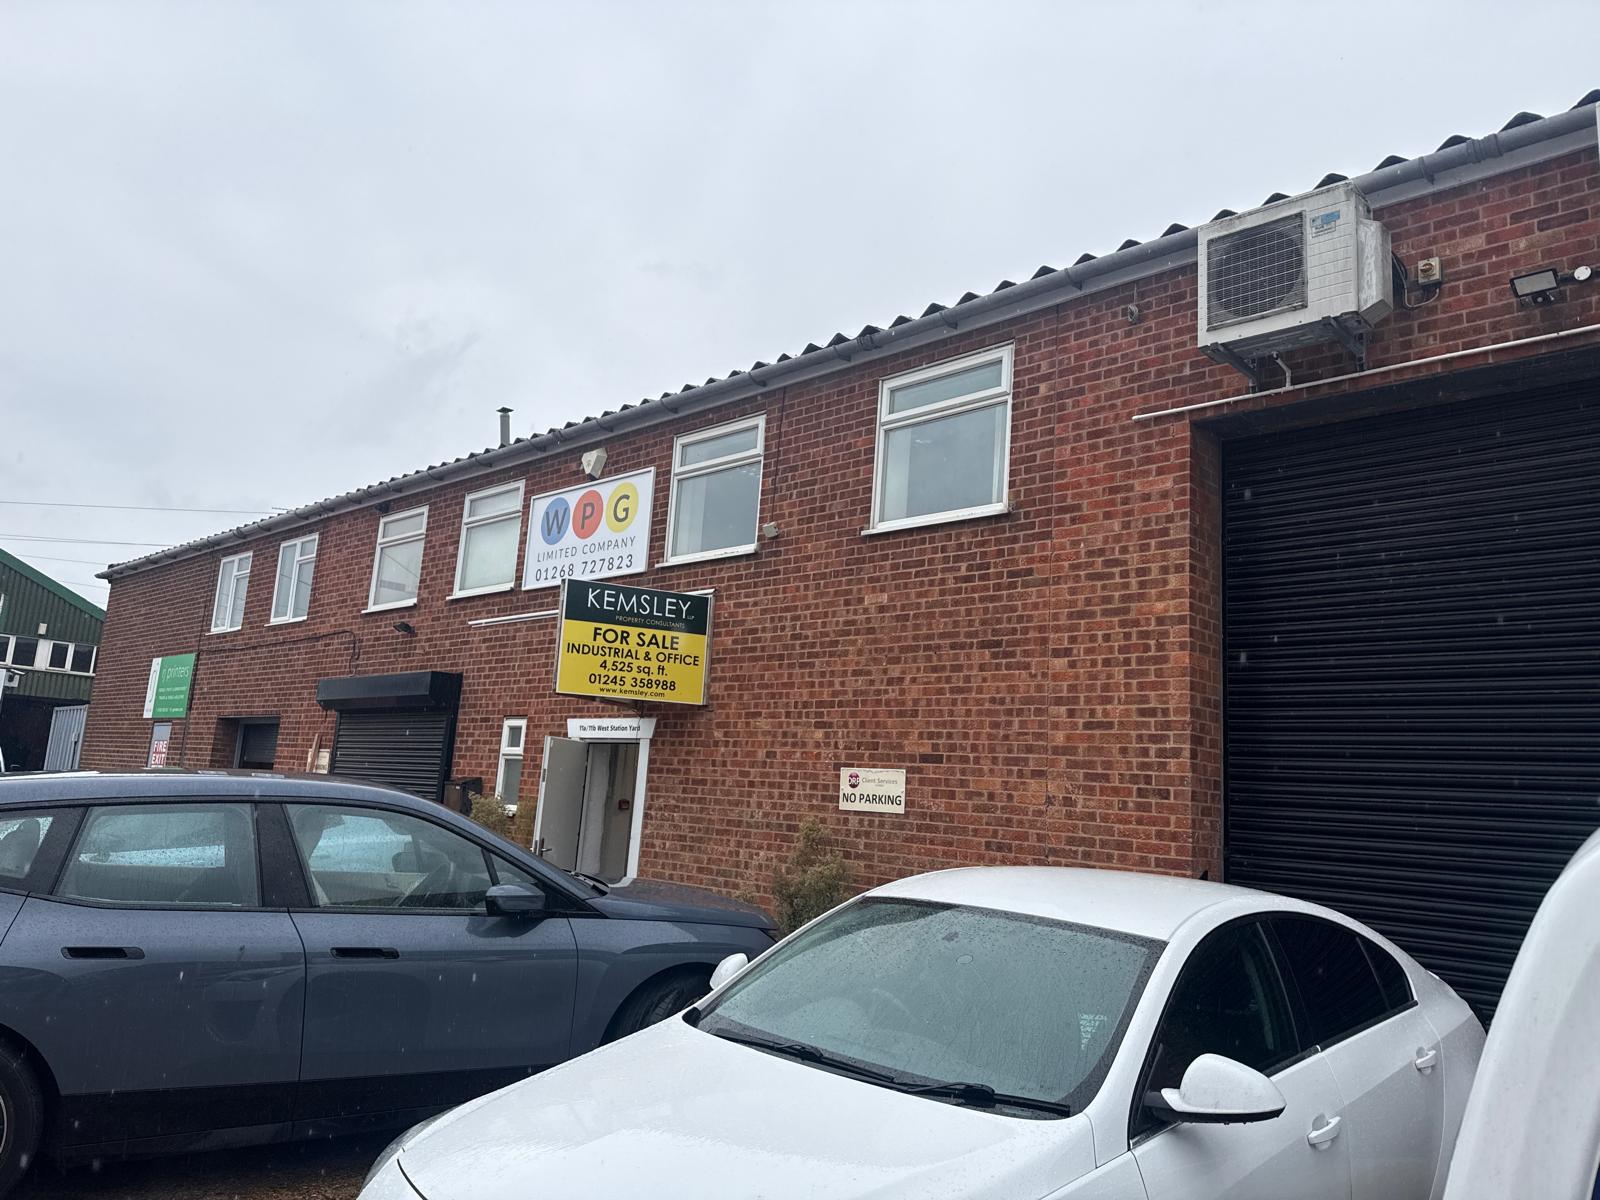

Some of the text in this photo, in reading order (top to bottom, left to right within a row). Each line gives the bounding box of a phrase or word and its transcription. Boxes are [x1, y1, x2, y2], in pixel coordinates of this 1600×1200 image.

[537, 536, 636, 563] LIMITED COMPANY
[535, 554, 633, 582] 01268 727823
[587, 588, 691, 619] KEMSLEY
[615, 615, 686, 629] PROPERTY CONSULTANTS
[593, 627, 680, 650] FOR SALE
[566, 642, 699, 666] INDUSTRIAL & OFFICE
[599, 660, 668, 677] 4,525 sq. ft.
[588, 673, 676, 691] 01245 358988
[599, 686, 665, 698] www.kemsley.com
[153, 740, 168, 752] FIRE
[151, 753, 166, 765] EXIT
[842, 792, 902, 806] NO PARKING
